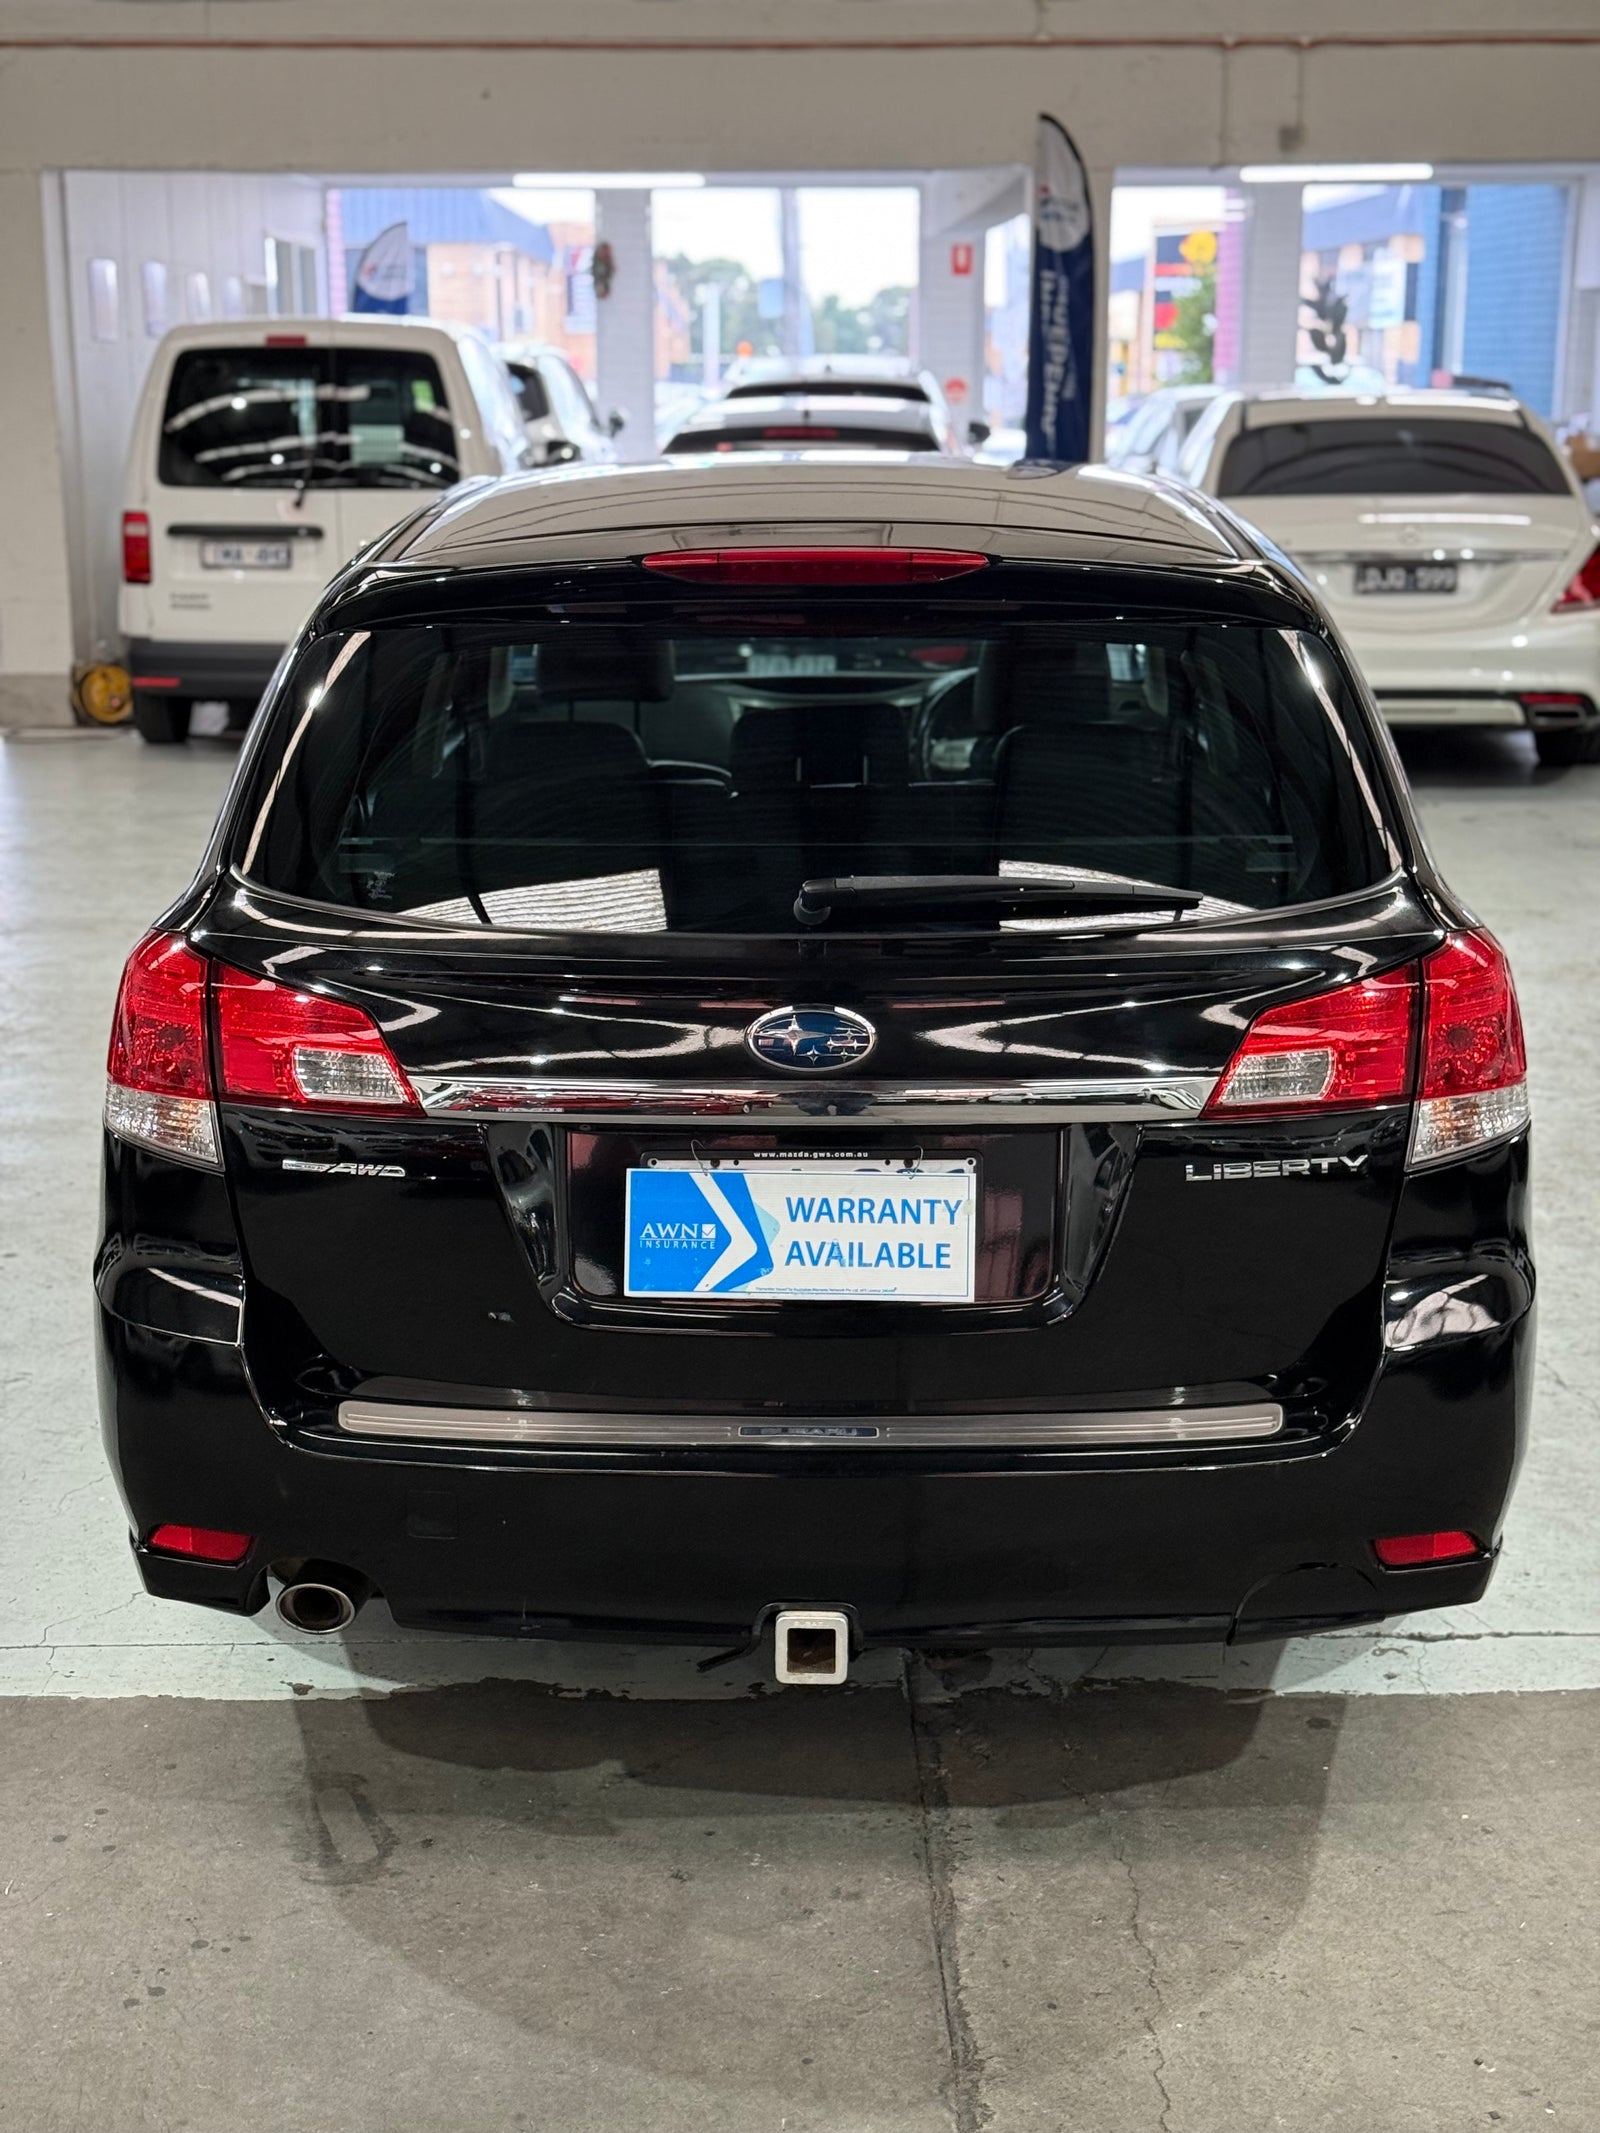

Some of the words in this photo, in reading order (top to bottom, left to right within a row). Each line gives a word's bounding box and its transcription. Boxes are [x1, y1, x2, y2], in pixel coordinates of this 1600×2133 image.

[328, 1162, 406, 1177] AWD
[1185, 1154, 1368, 1181] LIBERTY
[785, 1196, 963, 1225] WARRANTY
[640, 1222, 699, 1239] AWN
[639, 1240, 716, 1250] INSURANCE
[785, 1241, 951, 1268] AVAILABLE
